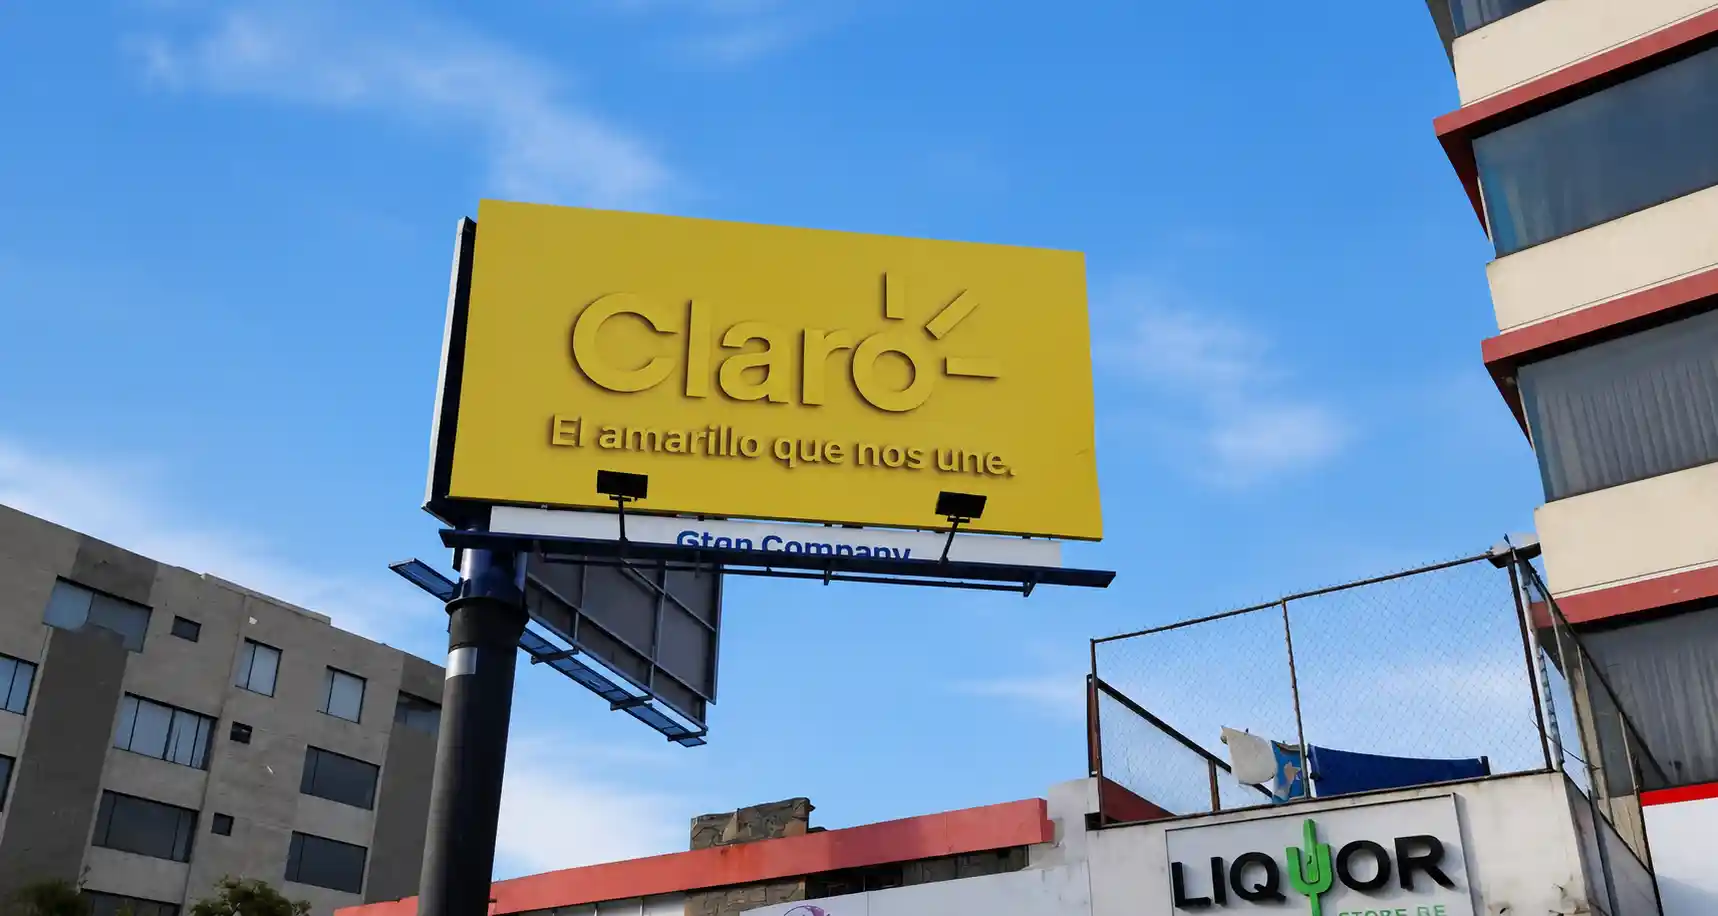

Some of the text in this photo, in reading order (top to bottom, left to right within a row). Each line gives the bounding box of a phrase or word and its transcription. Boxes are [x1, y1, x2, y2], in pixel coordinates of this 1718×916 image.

[571, 290, 936, 413] Claro
[551, 413, 1017, 477] El amarillo que nos une.
